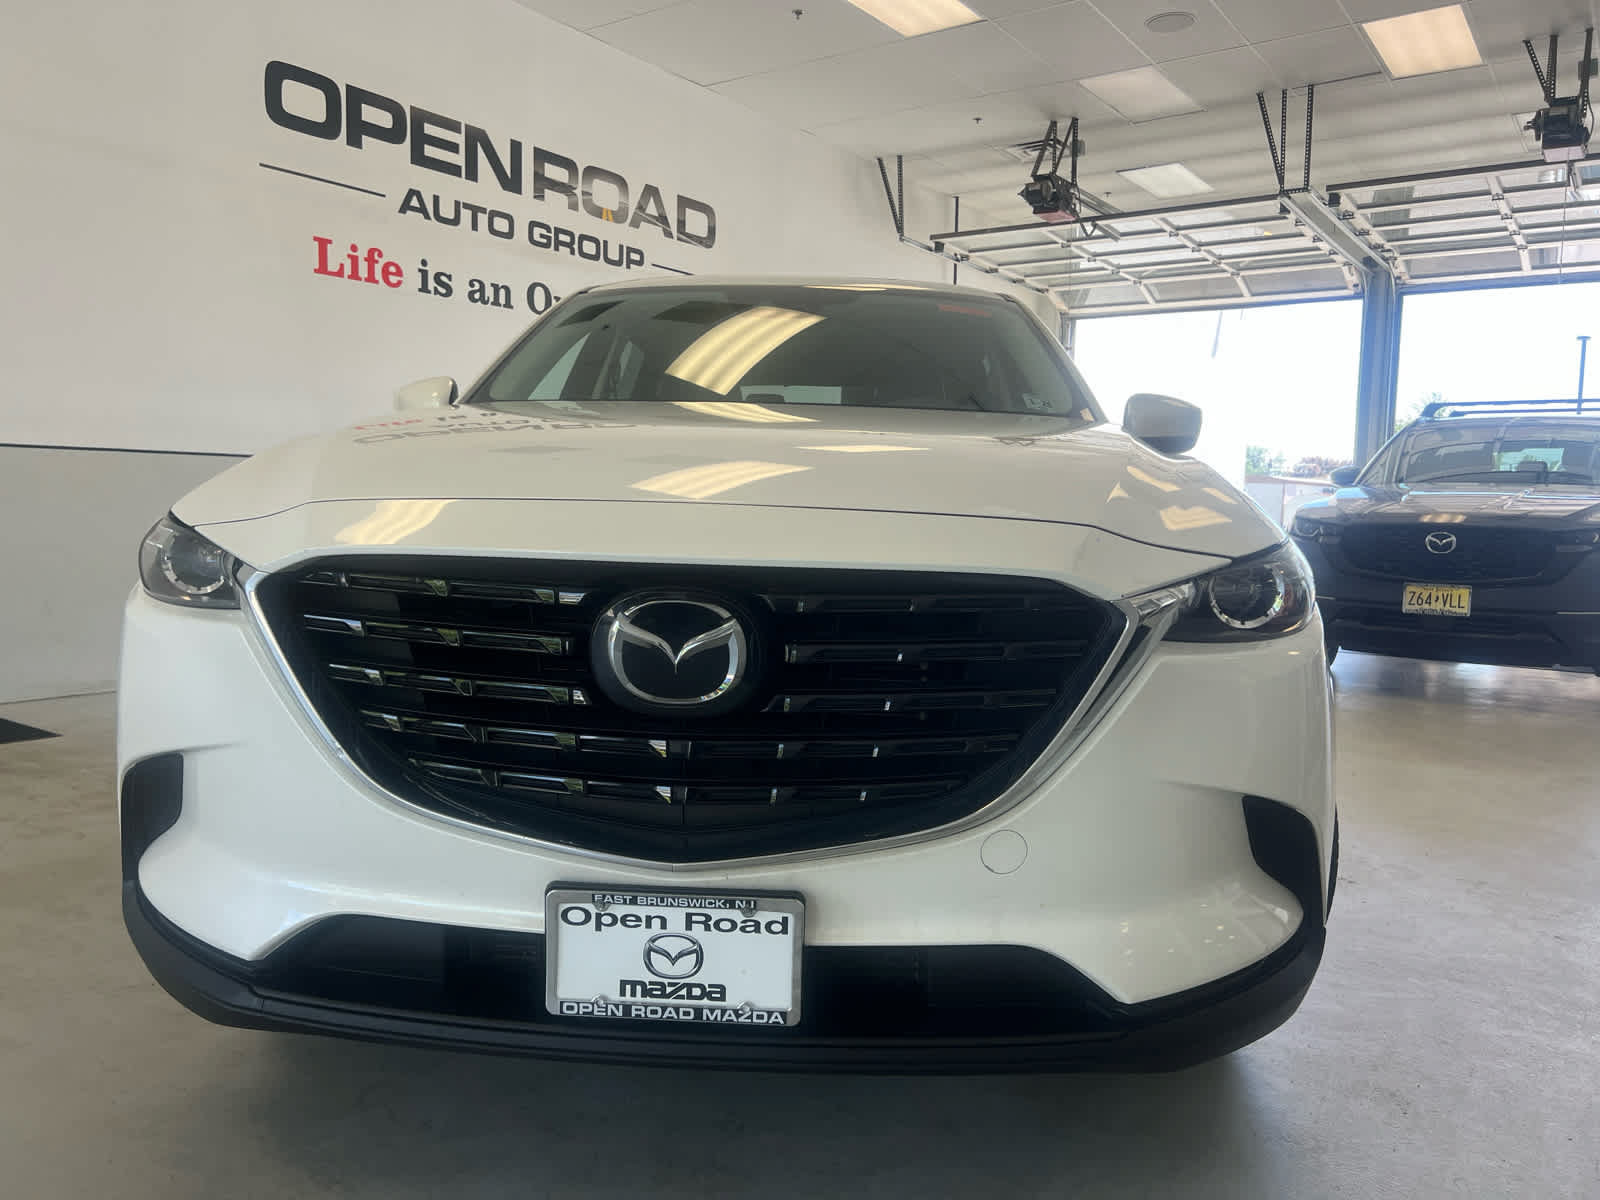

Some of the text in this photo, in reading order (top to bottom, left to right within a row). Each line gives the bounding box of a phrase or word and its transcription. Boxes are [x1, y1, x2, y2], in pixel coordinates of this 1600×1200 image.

[398, 188, 645, 270] AUTO GROUP
[312, 236, 404, 288] Life
[417, 258, 454, 298] is
[467, 278, 514, 310] an
[637, 895, 730, 909] BRUNSWICK,
[560, 906, 789, 936] Open Road
[619, 979, 727, 1002] mazda
[562, 1001, 785, 1025] OPEN ROAD MAZDA
